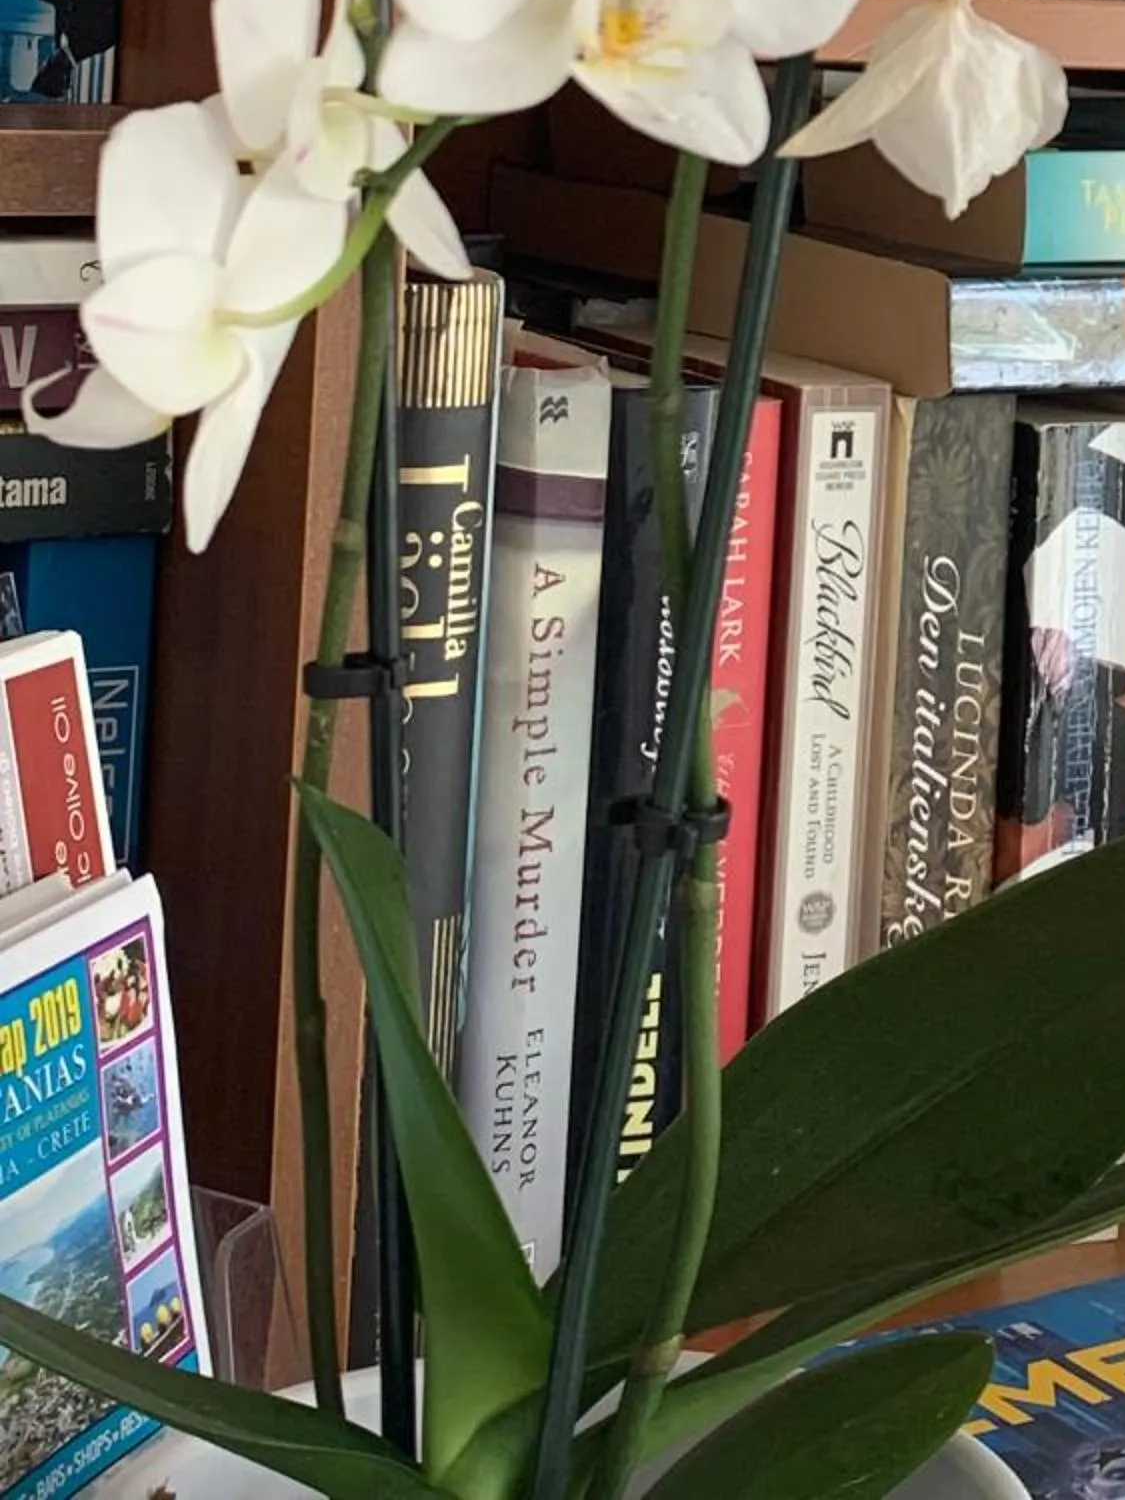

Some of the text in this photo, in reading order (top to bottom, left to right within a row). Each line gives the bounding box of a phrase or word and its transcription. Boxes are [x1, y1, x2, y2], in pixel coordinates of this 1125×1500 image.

[444, 500, 484, 661] Camilla
[718, 577, 751, 667] LARK
[803, 518, 867, 722] Blackbird
[918, 554, 962, 680] Den
[63, 753, 85, 841] Olive
[509, 562, 567, 996] A Simple Murder
[946, 627, 986, 852] LUCINDA
[803, 733, 826, 879] LOST AND FOUND
[822, 763, 840, 865] CHILDHOOD
[29, 977, 82, 1057] 2019
[0, 1043, 87, 1125] ANIAS
[37, 1109, 92, 1160] CRETE
[490, 1053, 518, 1177] KUHNS
[517, 1027, 545, 1193] ELEANOR
[73, 1429, 113, 1474] SHOPS
